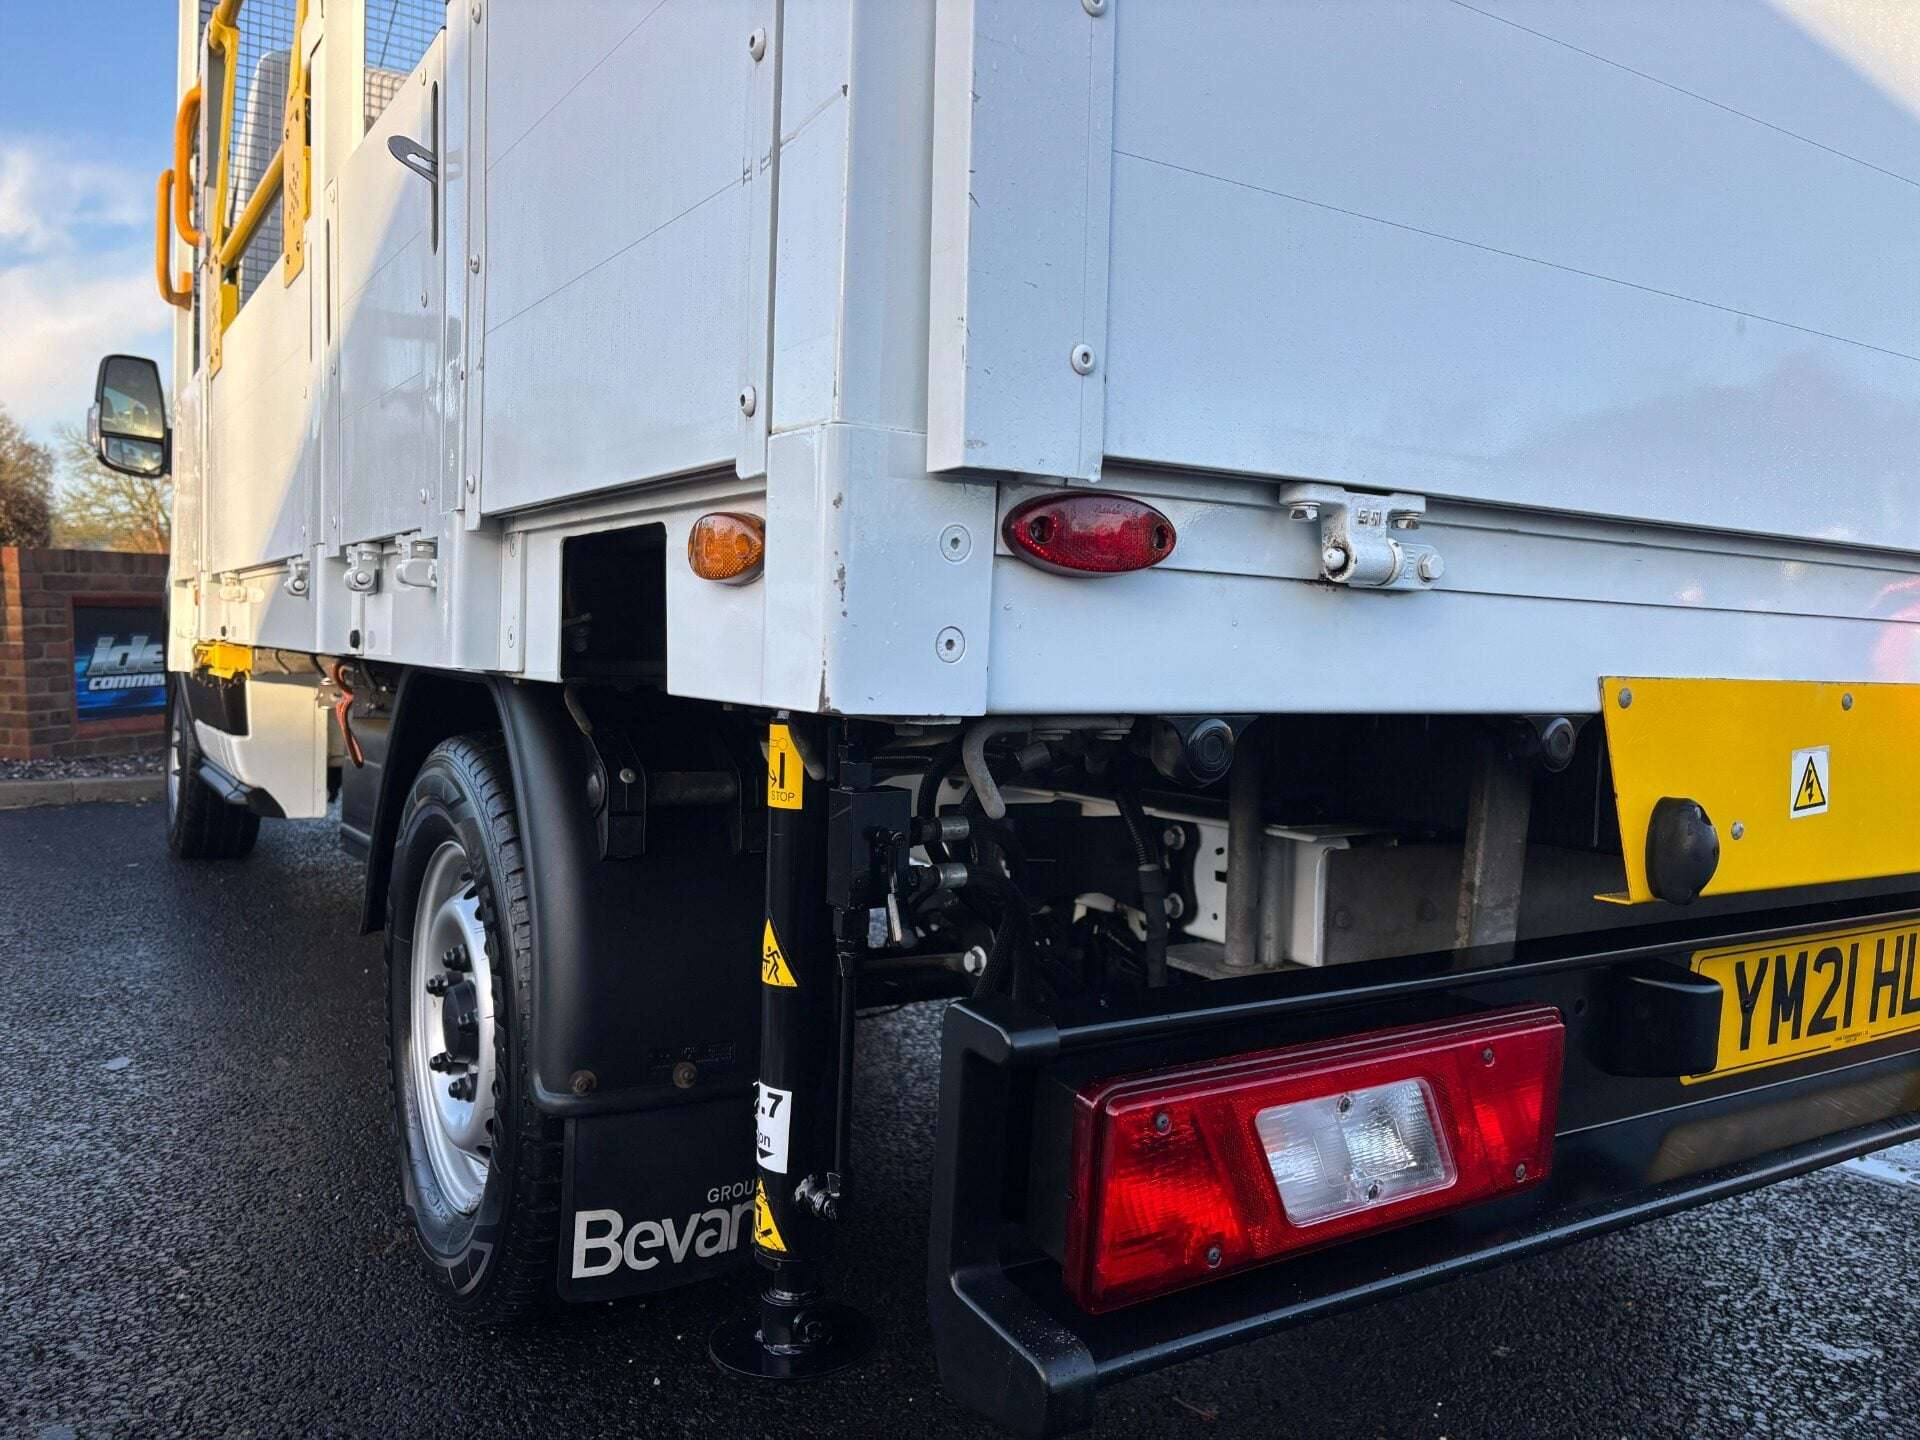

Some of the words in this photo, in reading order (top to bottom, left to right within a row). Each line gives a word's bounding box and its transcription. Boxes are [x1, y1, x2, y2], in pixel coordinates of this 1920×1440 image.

[772, 790, 795, 802] STOP
[1735, 943, 1859, 1051] YM21
[1869, 933, 1920, 1023] HL
[756, 1092, 783, 1118] .7
[757, 1129, 771, 1148] on
[572, 1201, 756, 1279] Bevan
